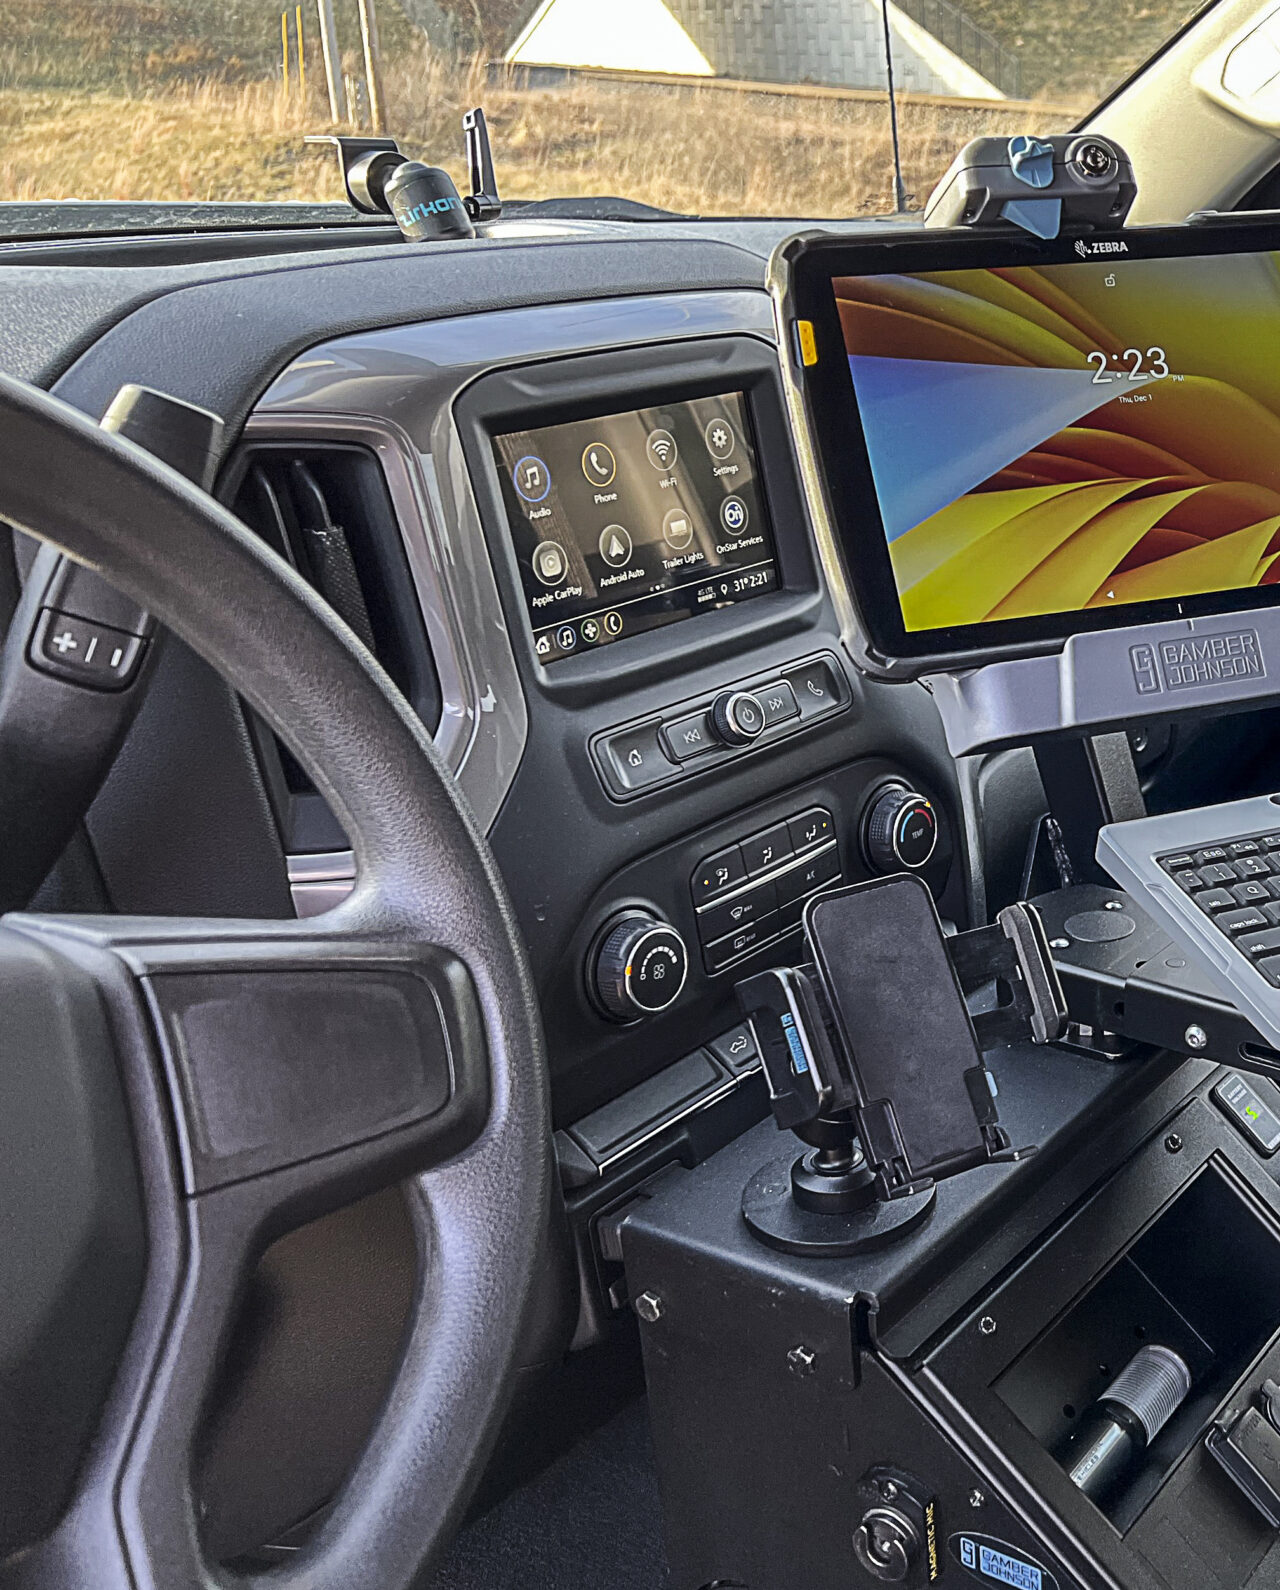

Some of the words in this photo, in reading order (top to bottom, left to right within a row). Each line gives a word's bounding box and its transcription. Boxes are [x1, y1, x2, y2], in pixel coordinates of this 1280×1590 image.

[1092, 241, 1128, 254] ZEBRA
[1087, 347, 1169, 384] 2:23
[1172, 374, 1185, 382] PM
[1134, 394, 1147, 402] Dec
[713, 464, 739, 477] Settings
[659, 477, 677, 489] Wi-Fi
[594, 492, 618, 505] Phone
[528, 507, 552, 520] Audio
[716, 541, 738, 554] OnStar
[738, 535, 764, 549] Services
[662, 556, 683, 570] Trailer
[684, 552, 704, 567] Lights
[600, 572, 626, 587] Android
[627, 568, 645, 580] Auto
[749, 571, 768, 587] 2:21
[532, 594, 554, 607] Apple
[555, 585, 583, 602] CarPlay
[1163, 633, 1255, 665] GAMBER
[1170, 654, 1260, 686] JOHNSON
[1247, 886, 1259, 894] Q
[1229, 920, 1245, 929] caps
[1250, 943, 1267, 953] shift
[982, 1549, 1039, 1580] GAMBER
[983, 1562, 1039, 1590] JOHNSON
